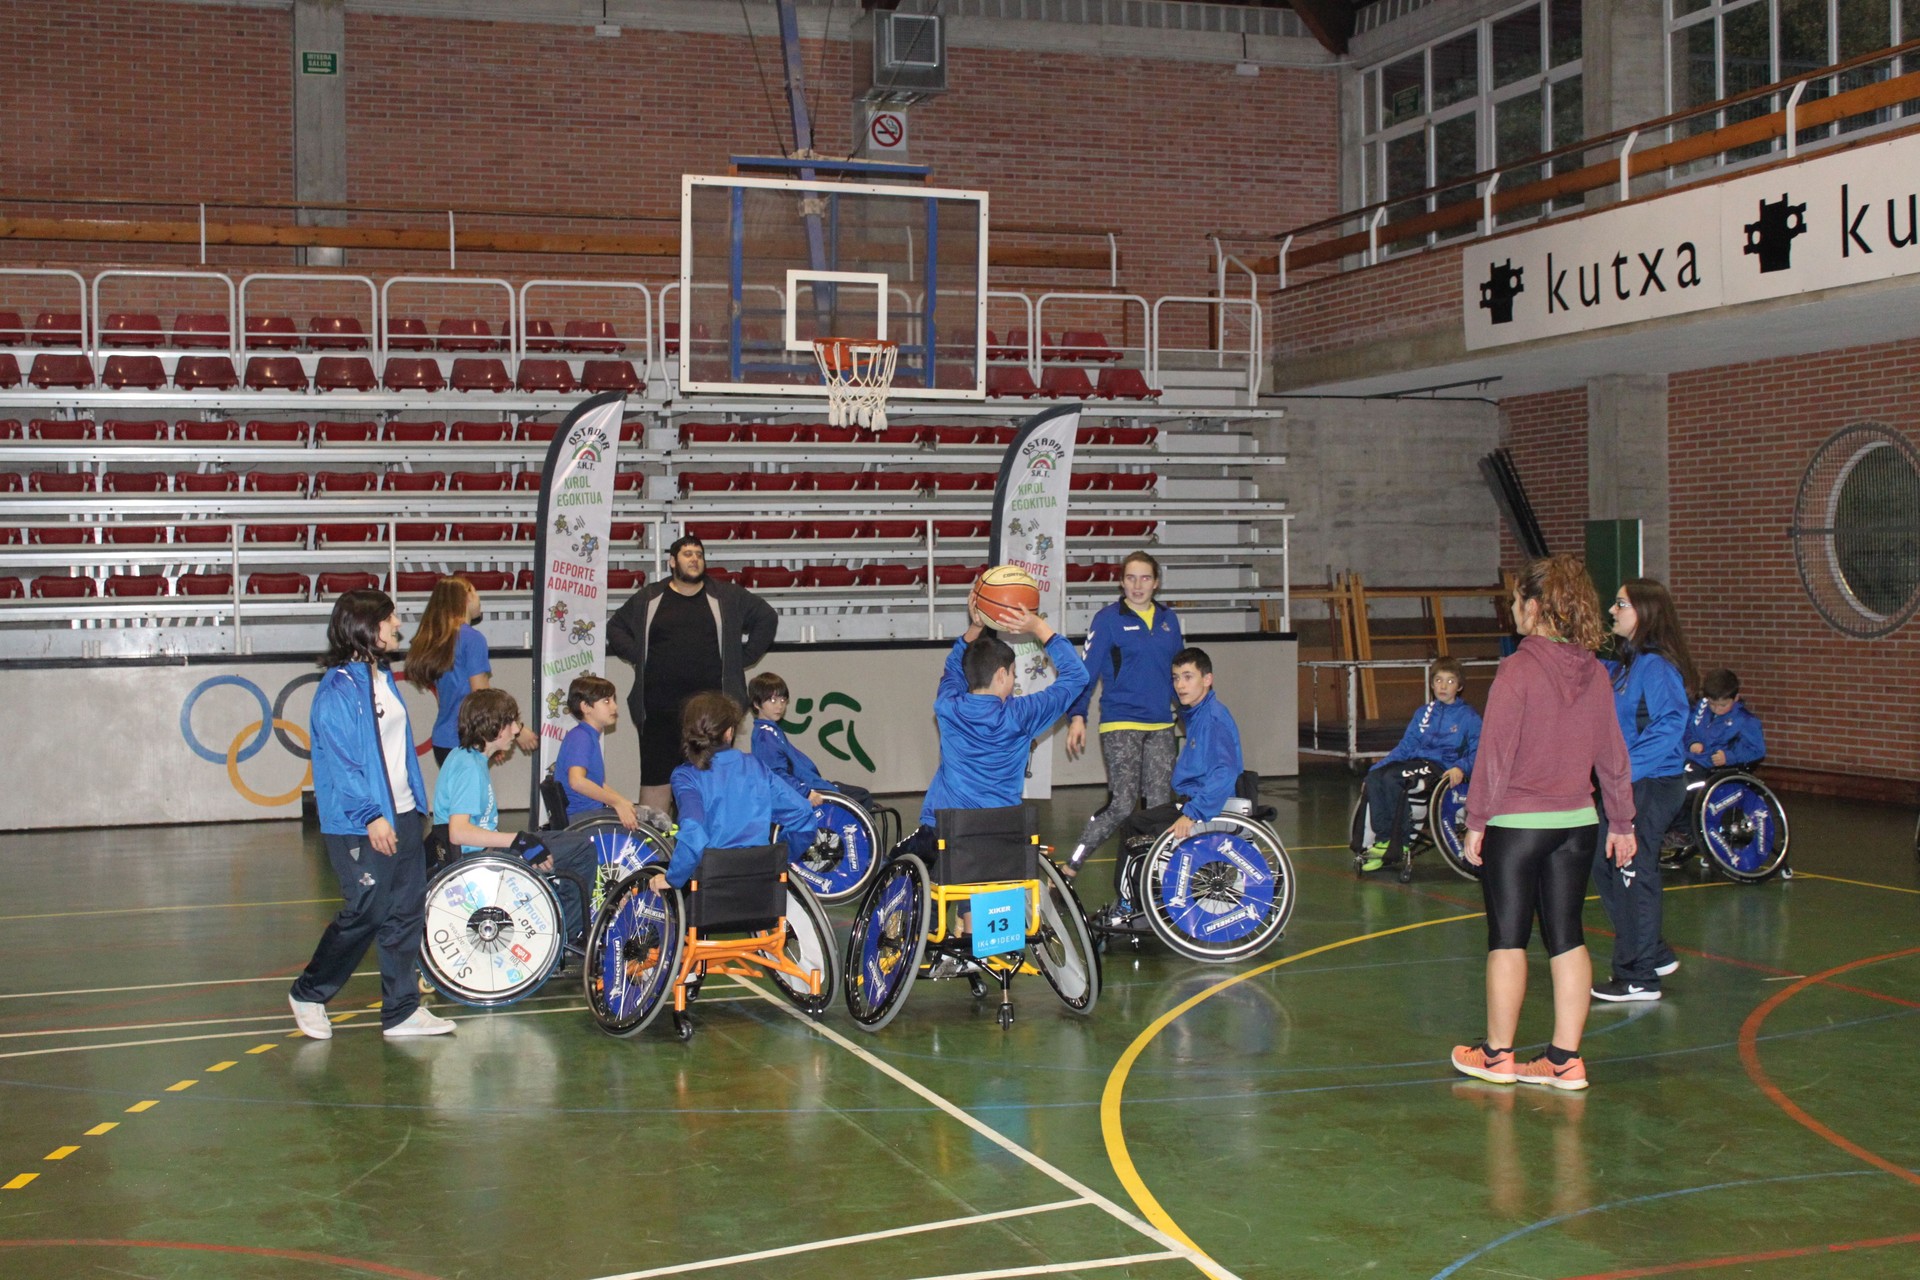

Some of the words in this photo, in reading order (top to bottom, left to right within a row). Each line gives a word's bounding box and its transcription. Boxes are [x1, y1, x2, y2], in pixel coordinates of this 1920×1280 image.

[1547, 241, 1701, 314] kutxa
[568, 426, 611, 451] OSTADAR
[1022, 437, 1065, 459] OSTADAR
[564, 475, 591, 490] KIROL
[1018, 482, 1045, 497] KIROL
[557, 492, 603, 507] EGOKITUA
[1011, 496, 1057, 512] EGOKITUA
[552, 559, 596, 582] DEPORTE
[547, 576, 598, 599] ADAPTADO
[543, 650, 594, 677] INCLUSIÓN
[847, 833, 859, 870] MICHELIN
[1176, 855, 1190, 898] MICHELIN
[1227, 849, 1265, 882] MICHELIN
[988, 905, 1012, 915] XIKER
[1205, 910, 1248, 932] MICHELIN
[987, 917, 1010, 934] 13
[997, 934, 1021, 945] IDEKO
[434, 929, 473, 979] SALTO
